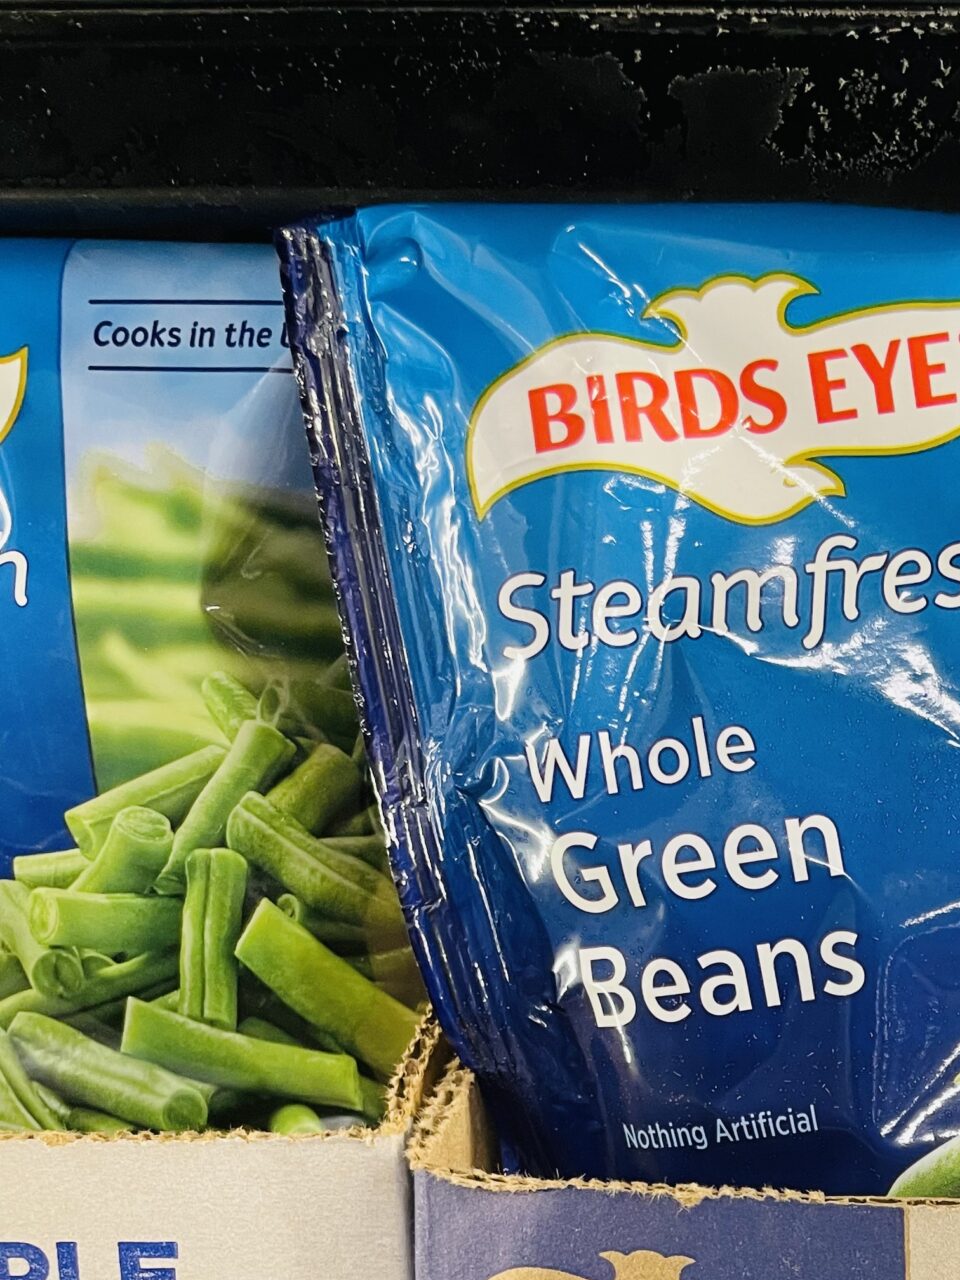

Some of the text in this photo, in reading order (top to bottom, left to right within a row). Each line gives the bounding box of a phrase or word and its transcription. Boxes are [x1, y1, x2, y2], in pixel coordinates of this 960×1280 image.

[93, 319, 182, 348] Cooks
[189, 320, 216, 348] in
[224, 319, 273, 348] the
[527, 357, 787, 454] BIRDS
[525, 716, 756, 803] Whole
[550, 813, 845, 915] Green
[579, 930, 866, 1029] Beans
[622, 1103, 819, 1150] Nothing Artificial
